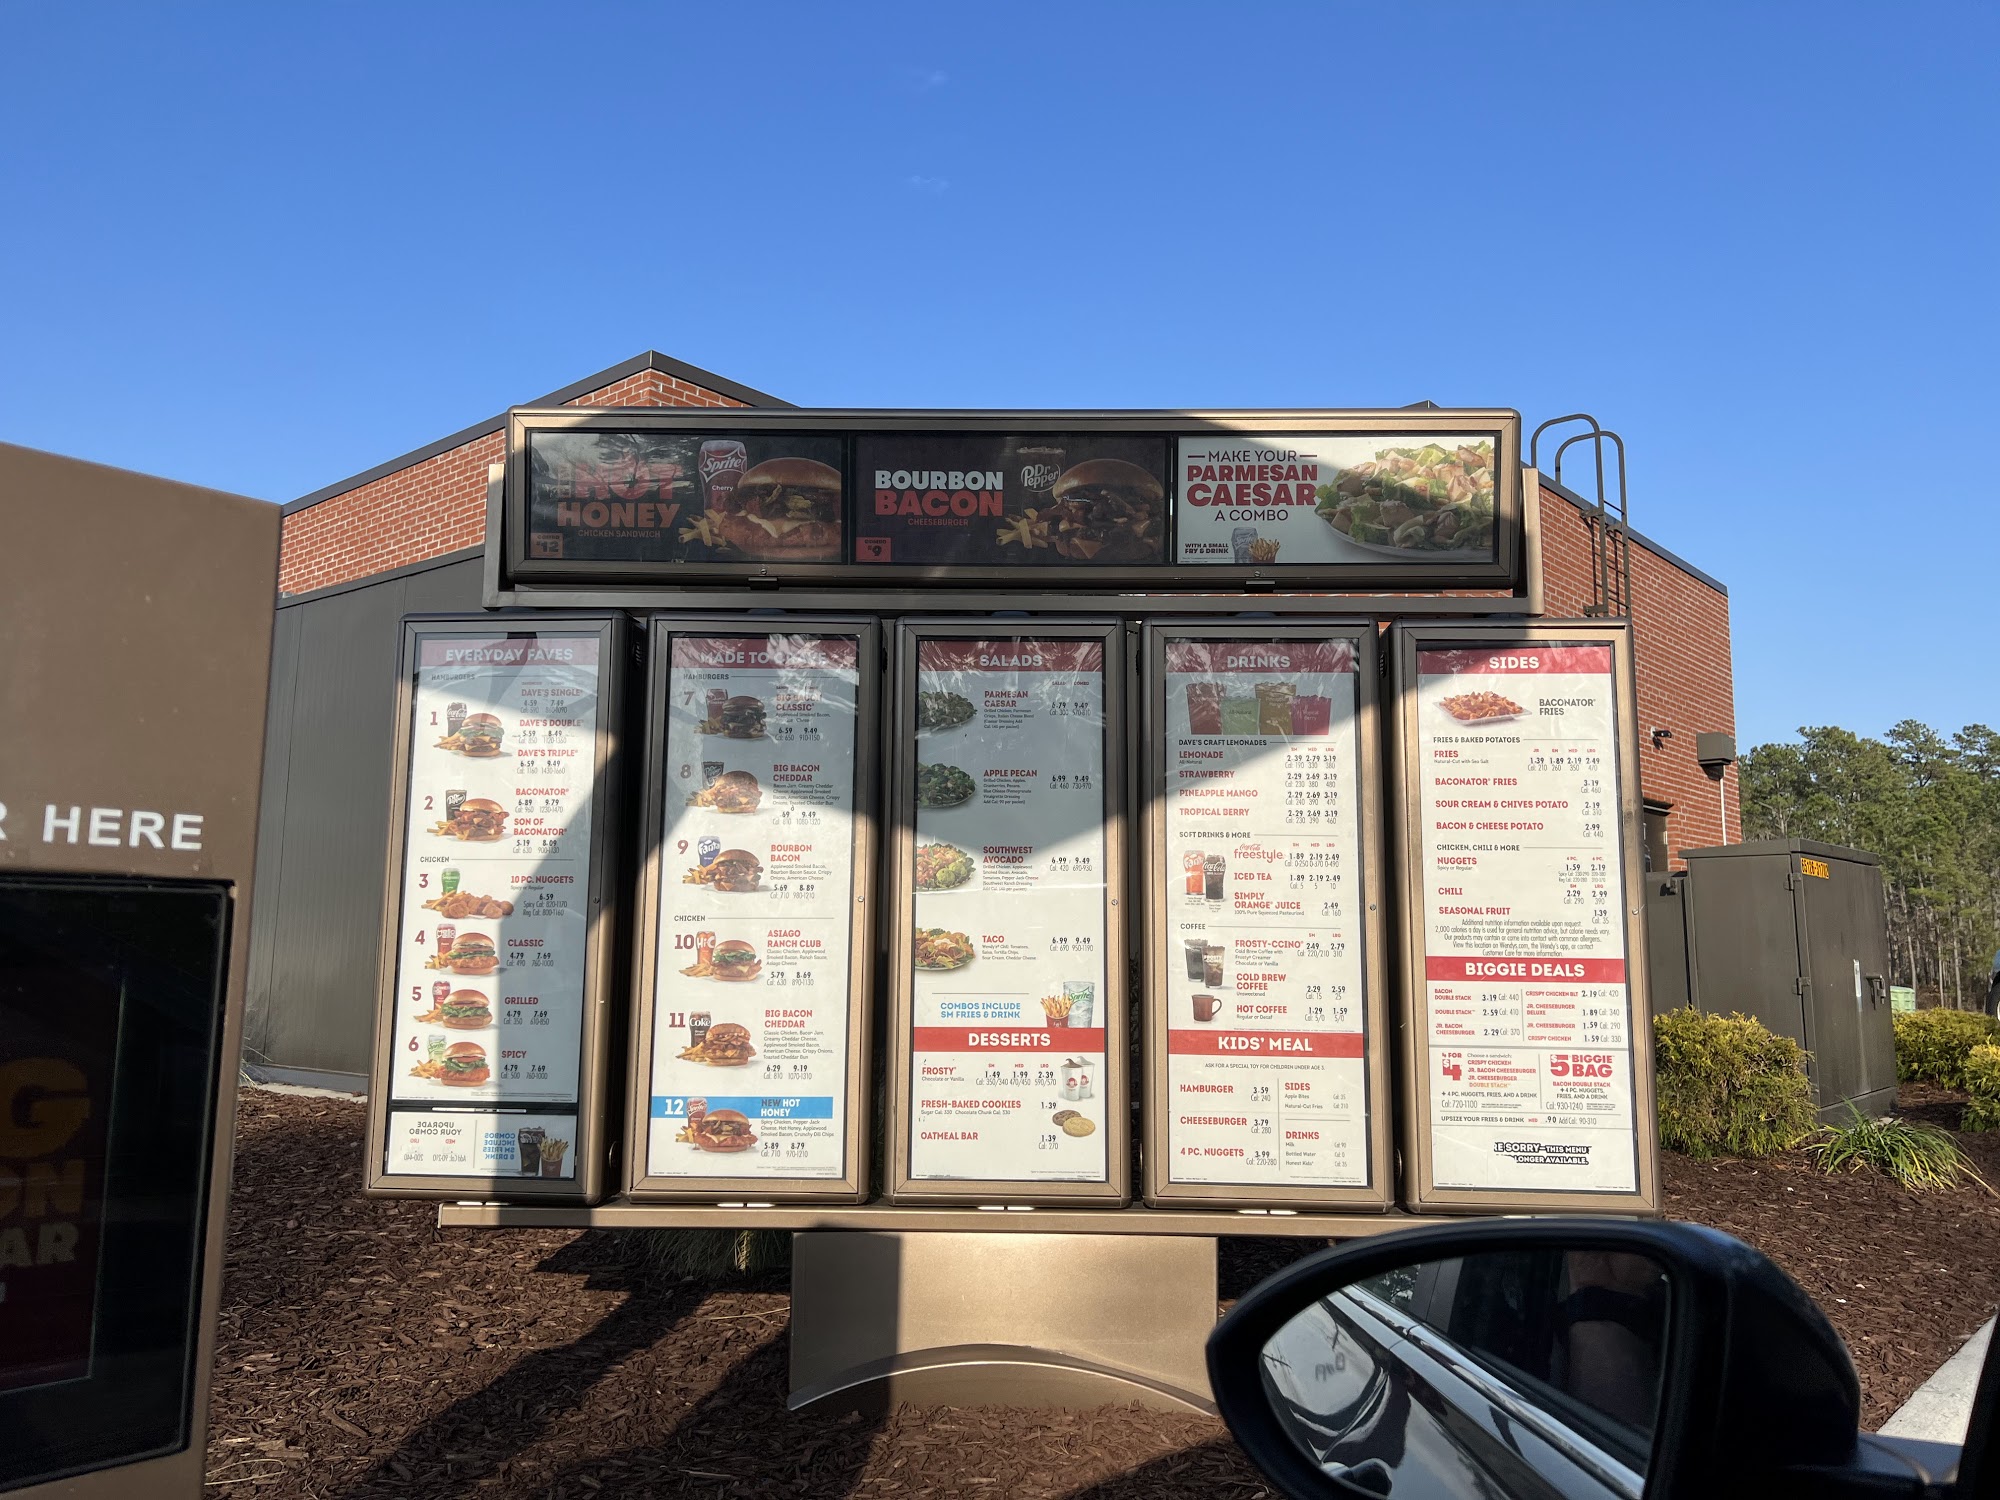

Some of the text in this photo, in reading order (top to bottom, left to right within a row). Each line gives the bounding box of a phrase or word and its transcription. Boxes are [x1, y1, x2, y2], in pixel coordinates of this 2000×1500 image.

[1209, 450, 1297, 462] MAKE YOUR
[704, 457, 742, 472] Sprite
[1188, 465, 1317, 481] PARMESAN
[875, 470, 1004, 490] BOURBON
[1187, 483, 1317, 507] CAESAR
[875, 490, 1003, 516] BACON
[557, 502, 681, 528] HONEY
[1215, 510, 1288, 521] A COMBO
[908, 518, 968, 526] CHEESEBURGER
[617, 530, 661, 538] SANDWICH
[446, 649, 573, 661] EVERYDAY FAVES
[700, 652, 745, 664] MADE
[749, 652, 769, 664] TO
[980, 655, 1042, 666] SALADS
[1227, 656, 1290, 667] DRINKS
[1489, 657, 1539, 669] SIDES
[773, 774, 812, 782] CHEDDAR
[1180, 808, 1221, 816] TROPICAL
[43, 804, 204, 850] HERE
[1436, 822, 1466, 830] BACON
[771, 844, 812, 852] BOURBON
[983, 846, 1033, 854] SOUTHWEST
[771, 854, 800, 862] BACON
[1235, 892, 1265, 900] SIMPLY
[1439, 907, 1510, 915] SEASONAL FRUIT
[508, 939, 544, 947] CLASSIC
[674, 935, 695, 949] 10
[1465, 962, 1585, 977] BIGGIE DEALS
[1237, 1005, 1254, 1013] HOT
[765, 1020, 805, 1028] CHEDDAR
[968, 1033, 1051, 1046] DESSERTS
[1218, 1037, 1313, 1051] KIDS' MEAL
[1572, 1055, 1612, 1063] BIGGIE
[1572, 1065, 1612, 1078] BAG
[1180, 1084, 1234, 1093] HAMBURGER
[665, 1100, 683, 1115] 12
[921, 1100, 979, 1108] FRESH-BAKED
[761, 1109, 791, 1117] HONEY
[1180, 1117, 1247, 1125] CHEESEBURGER
[961, 1132, 978, 1140] BAR
